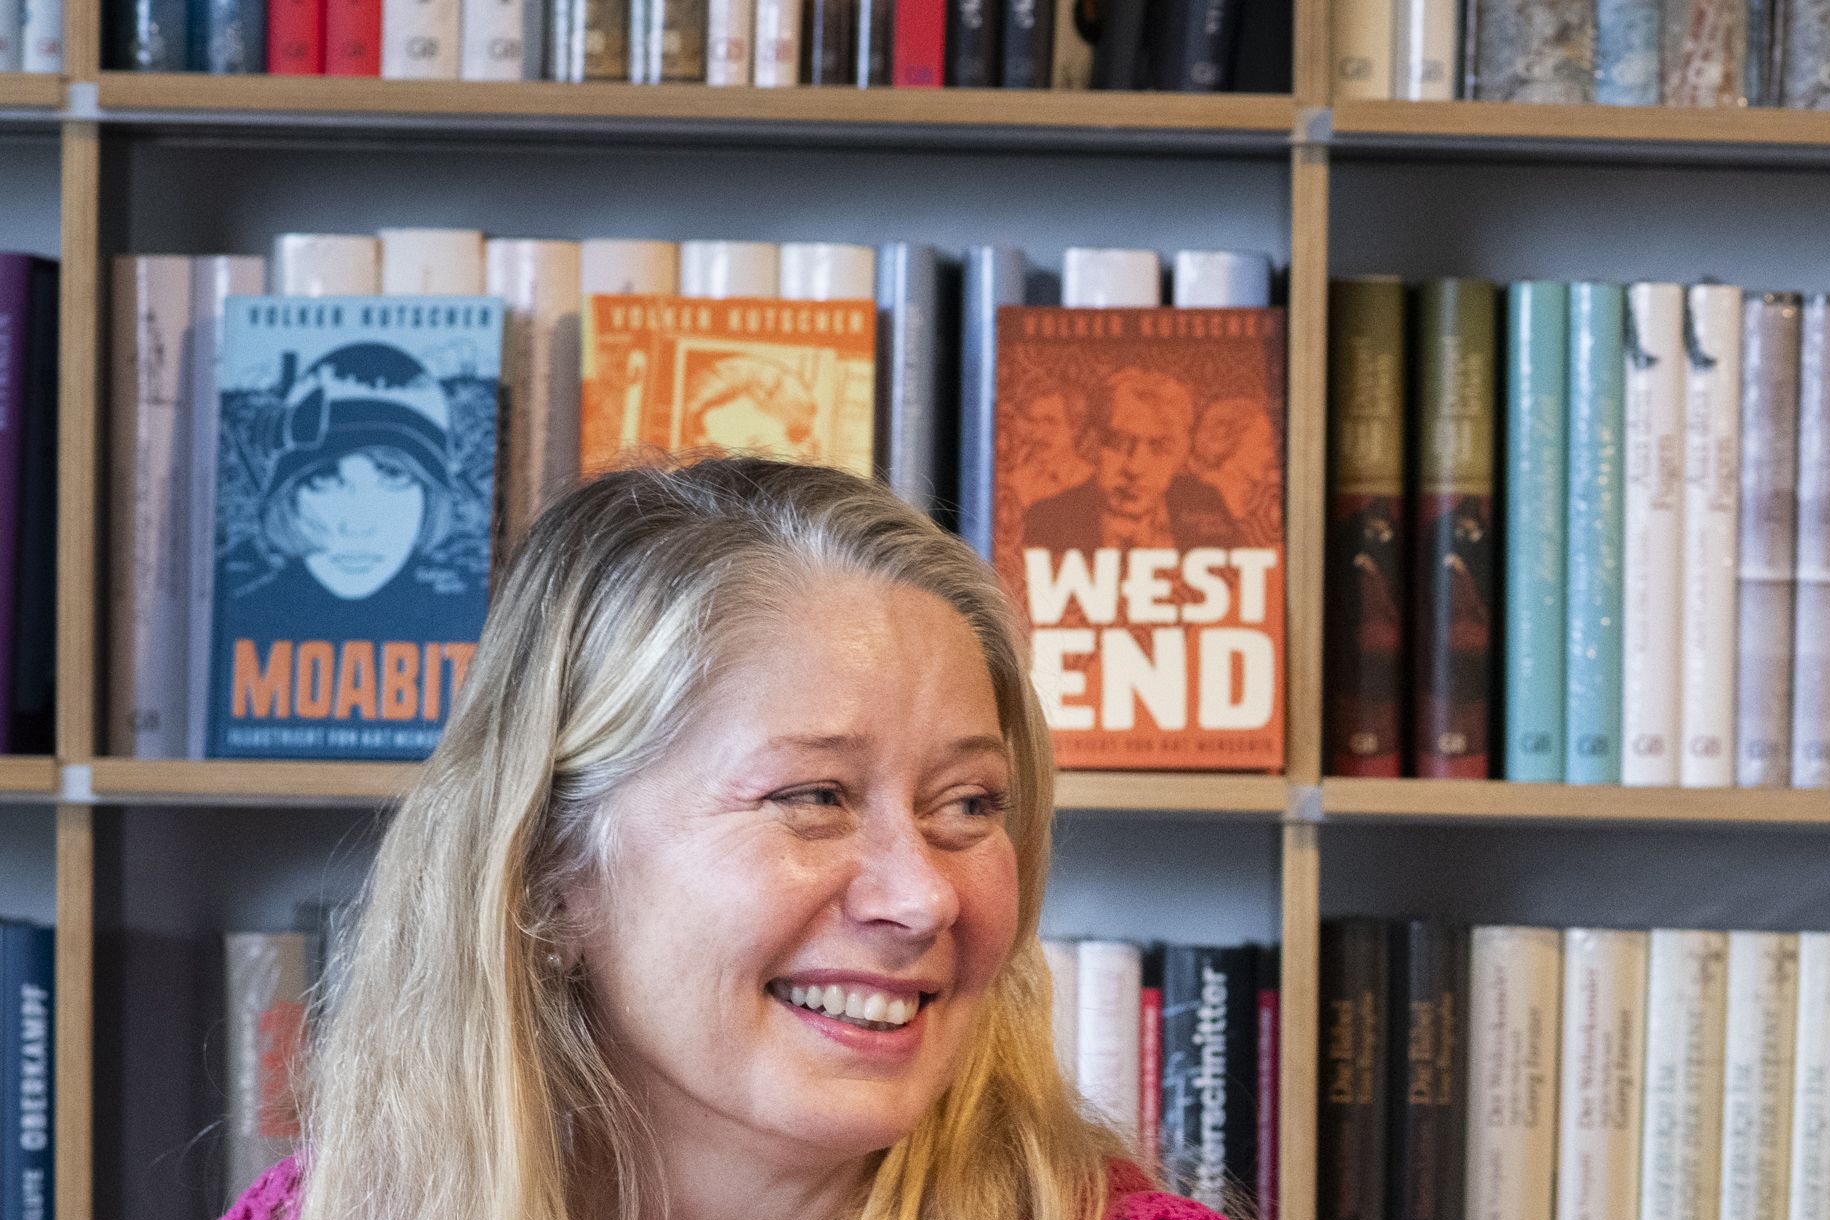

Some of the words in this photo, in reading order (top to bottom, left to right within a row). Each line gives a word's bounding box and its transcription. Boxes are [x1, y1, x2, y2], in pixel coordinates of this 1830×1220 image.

[1024, 547, 1277, 625] WEST
[231, 639, 479, 720] MOABIT
[1031, 627, 1275, 731] END
[19, 983, 47, 1151] OBERKAMPF
